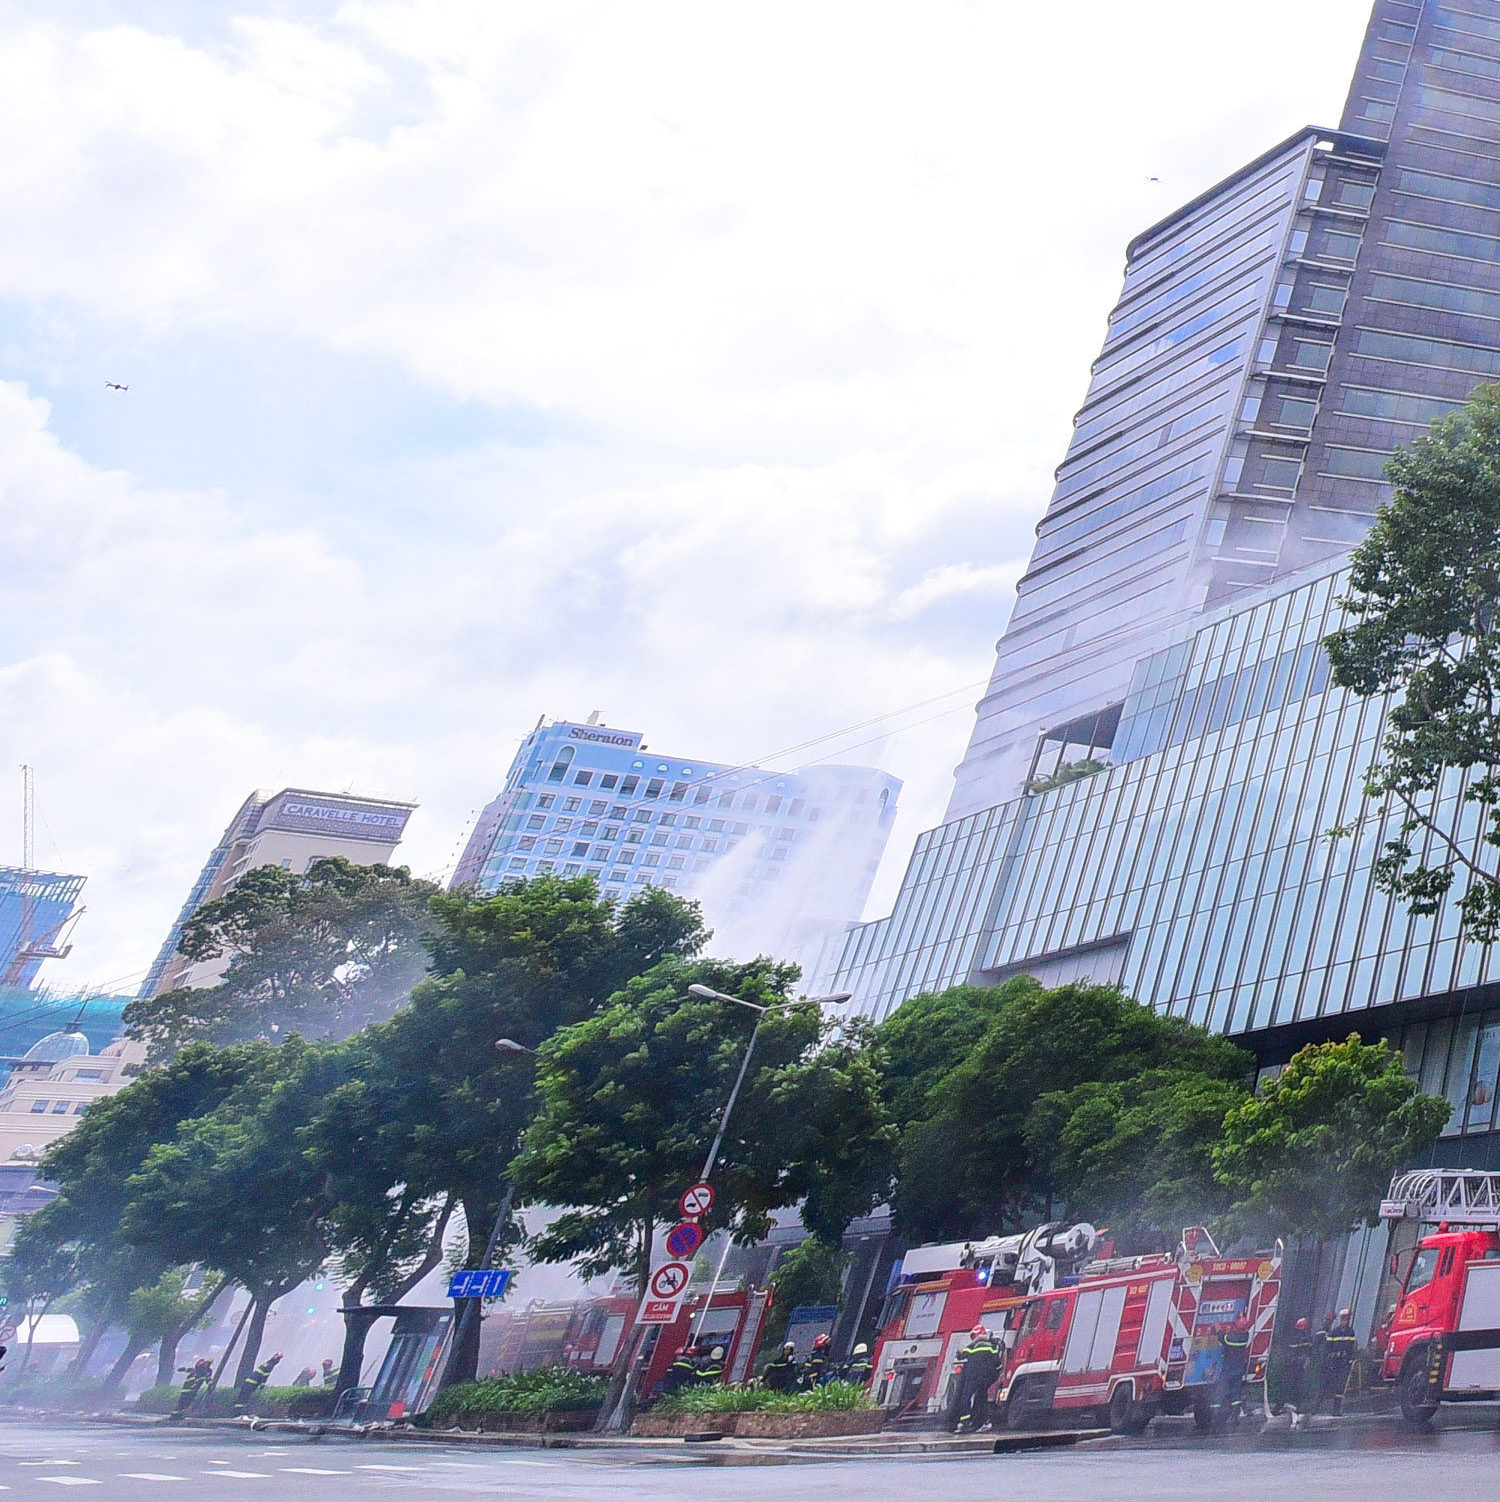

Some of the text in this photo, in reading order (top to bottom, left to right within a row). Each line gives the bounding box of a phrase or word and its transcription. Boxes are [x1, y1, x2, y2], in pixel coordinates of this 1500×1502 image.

[568, 727, 634, 747] Sheraton
[287, 805, 400, 826] CARAVELLE HOTEL
